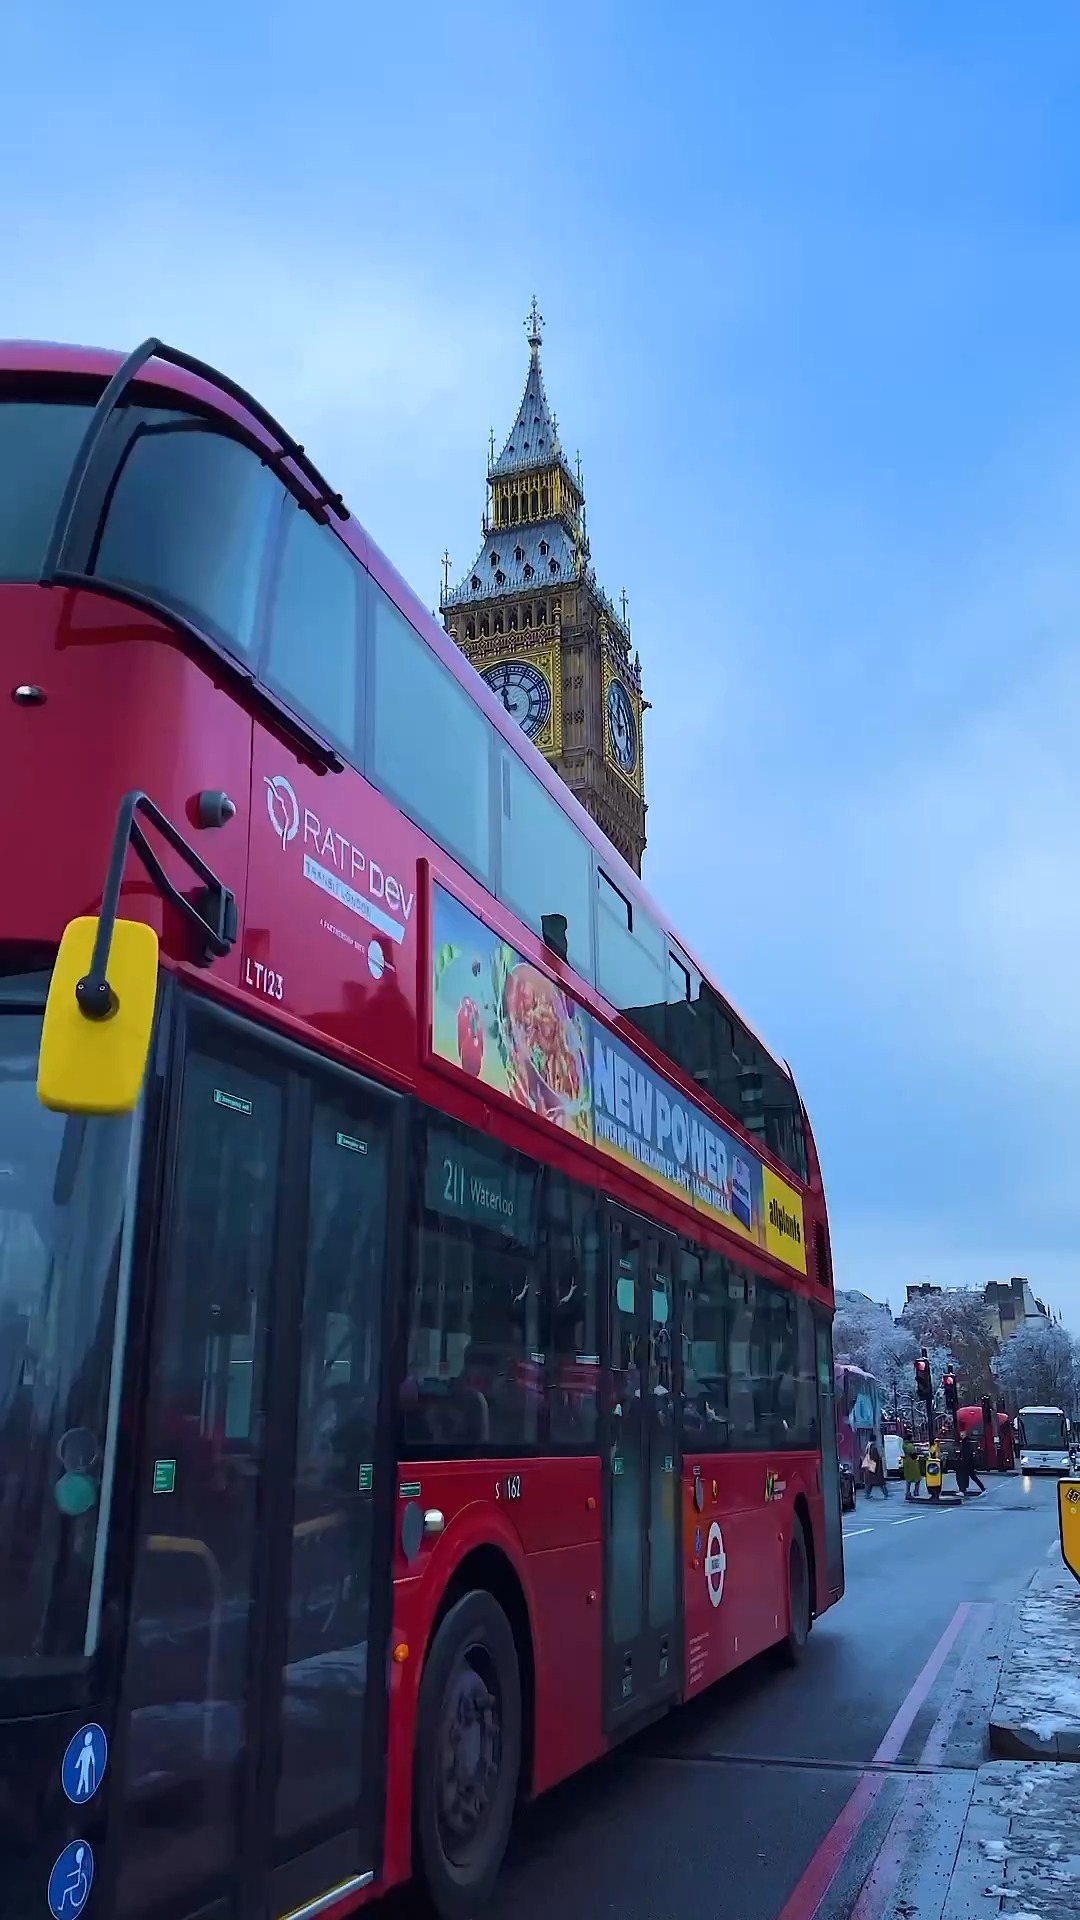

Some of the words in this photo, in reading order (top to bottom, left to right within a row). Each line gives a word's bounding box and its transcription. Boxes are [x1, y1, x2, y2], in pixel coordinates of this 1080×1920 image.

[246, 957, 283, 1000] LT123
[593, 1036, 653, 1141] NEW
[655, 1088, 729, 1195] POWER
[443, 1159, 464, 1206] 211
[470, 1176, 514, 1216] Waterloo
[507, 1475, 520, 1500] 162
